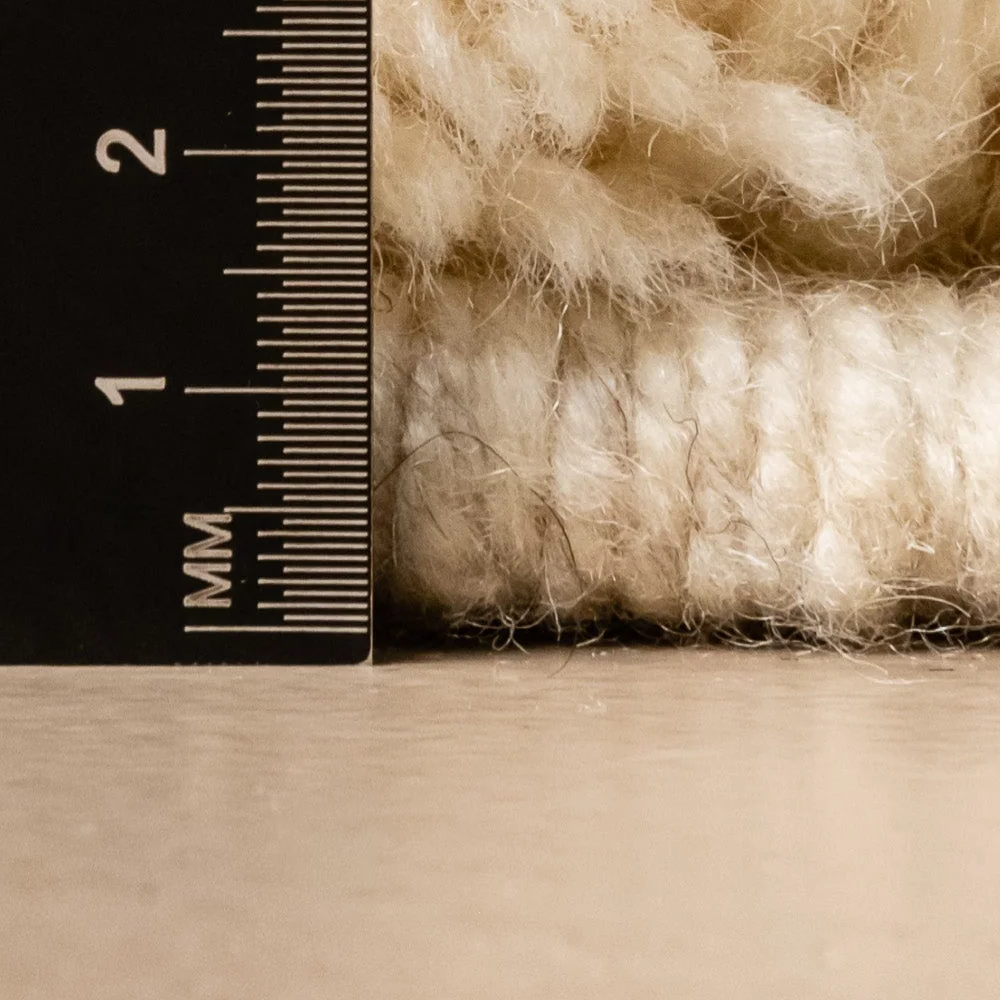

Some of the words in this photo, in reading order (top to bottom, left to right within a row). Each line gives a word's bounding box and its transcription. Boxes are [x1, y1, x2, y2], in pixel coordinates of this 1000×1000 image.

[95, 128, 167, 176] 2
[94, 376, 166, 406] 1
[183, 512, 233, 608] MM
